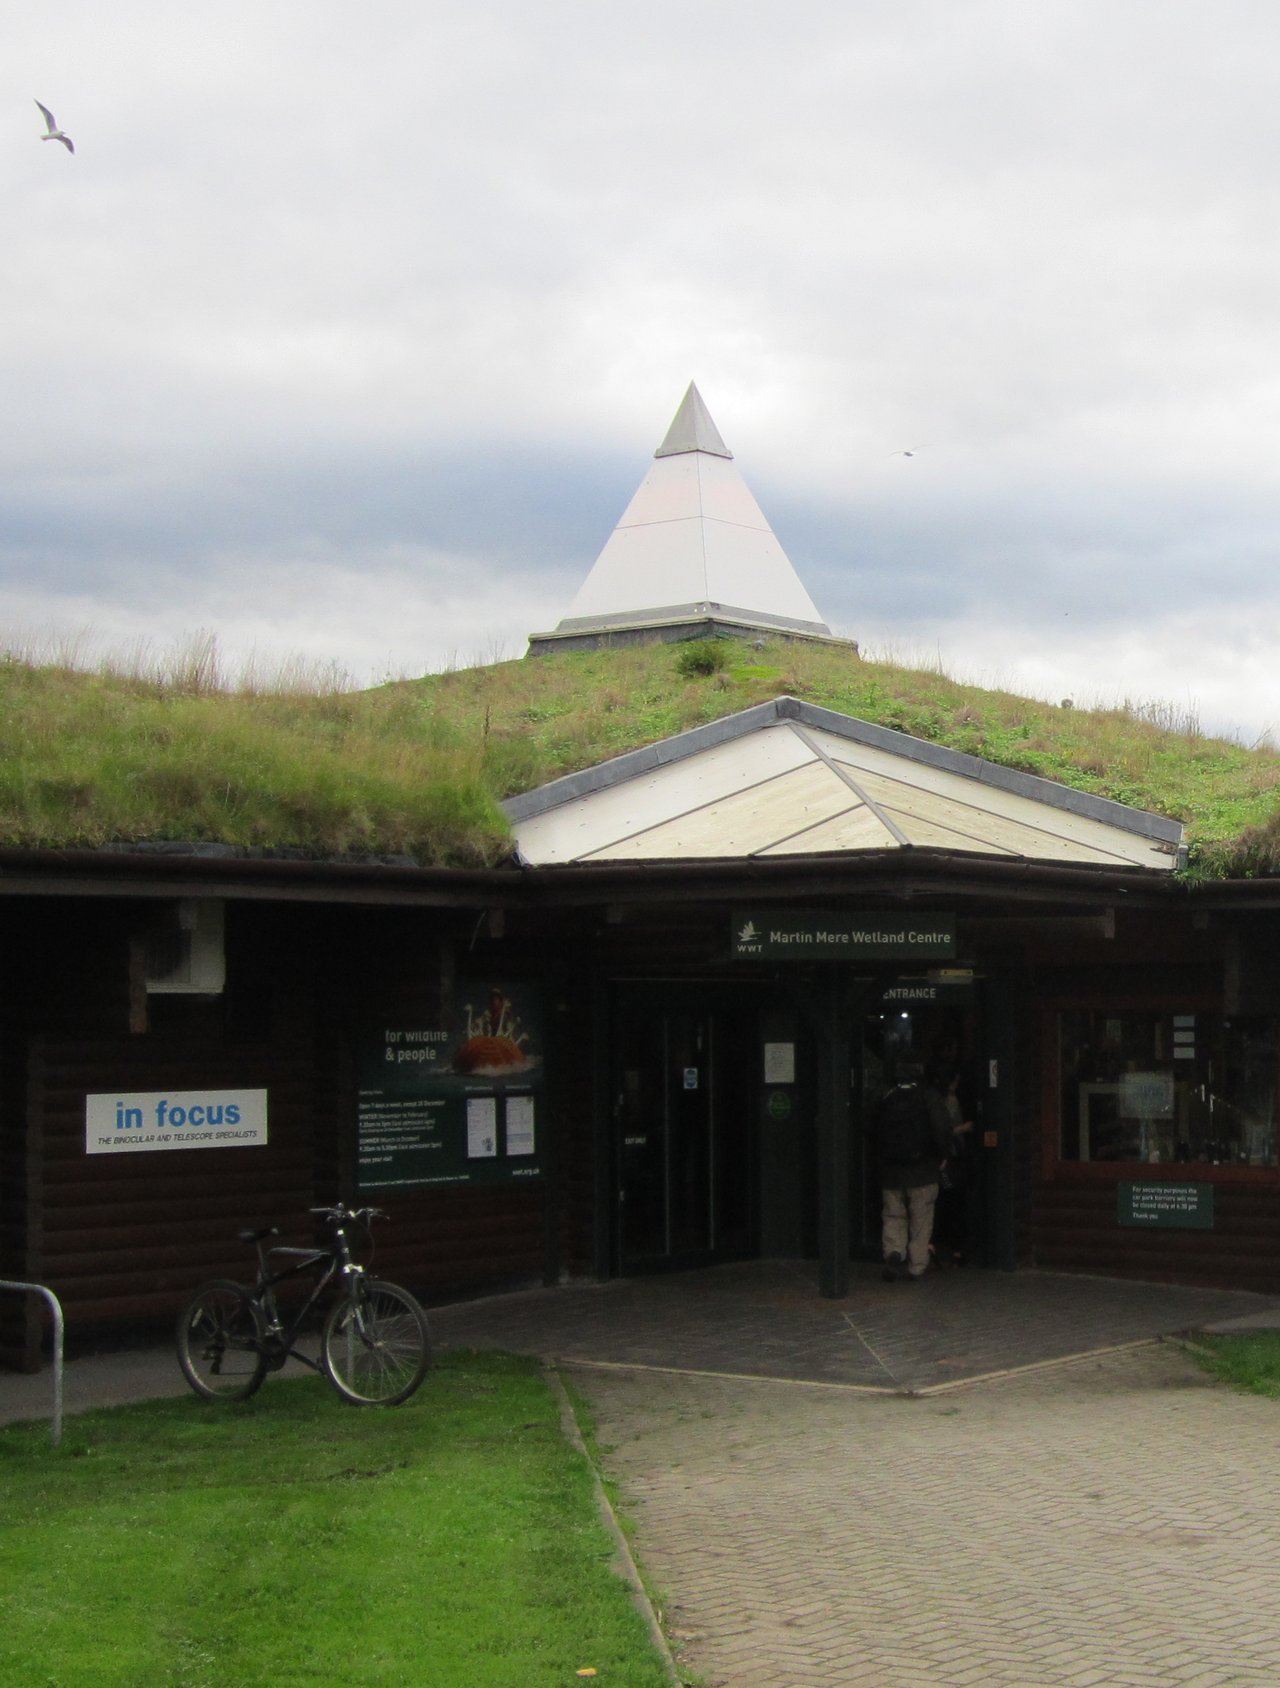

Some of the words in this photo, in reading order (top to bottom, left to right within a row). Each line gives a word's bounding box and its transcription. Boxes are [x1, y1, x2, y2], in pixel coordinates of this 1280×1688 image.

[770, 931, 812, 943] Martin
[816, 931, 849, 943] Mere
[852, 931, 904, 943] Wetland
[908, 931, 951, 943] Centre
[737, 944, 762, 953] WWT
[385, 1029, 401, 1042] for
[405, 1029, 448, 1042] wildlife
[385, 1047, 395, 1060] &
[398, 1046, 436, 1063] people
[116, 1101, 143, 1129] in
[155, 1100, 241, 1128] focus
[98, 1137, 111, 1145] THE
[114, 1134, 154, 1145] BINOCULAR
[157, 1134, 171, 1142] AND
[173, 1132, 213, 1142] TELESCOPE
[215, 1130, 257, 1140] SPECIALISTS
